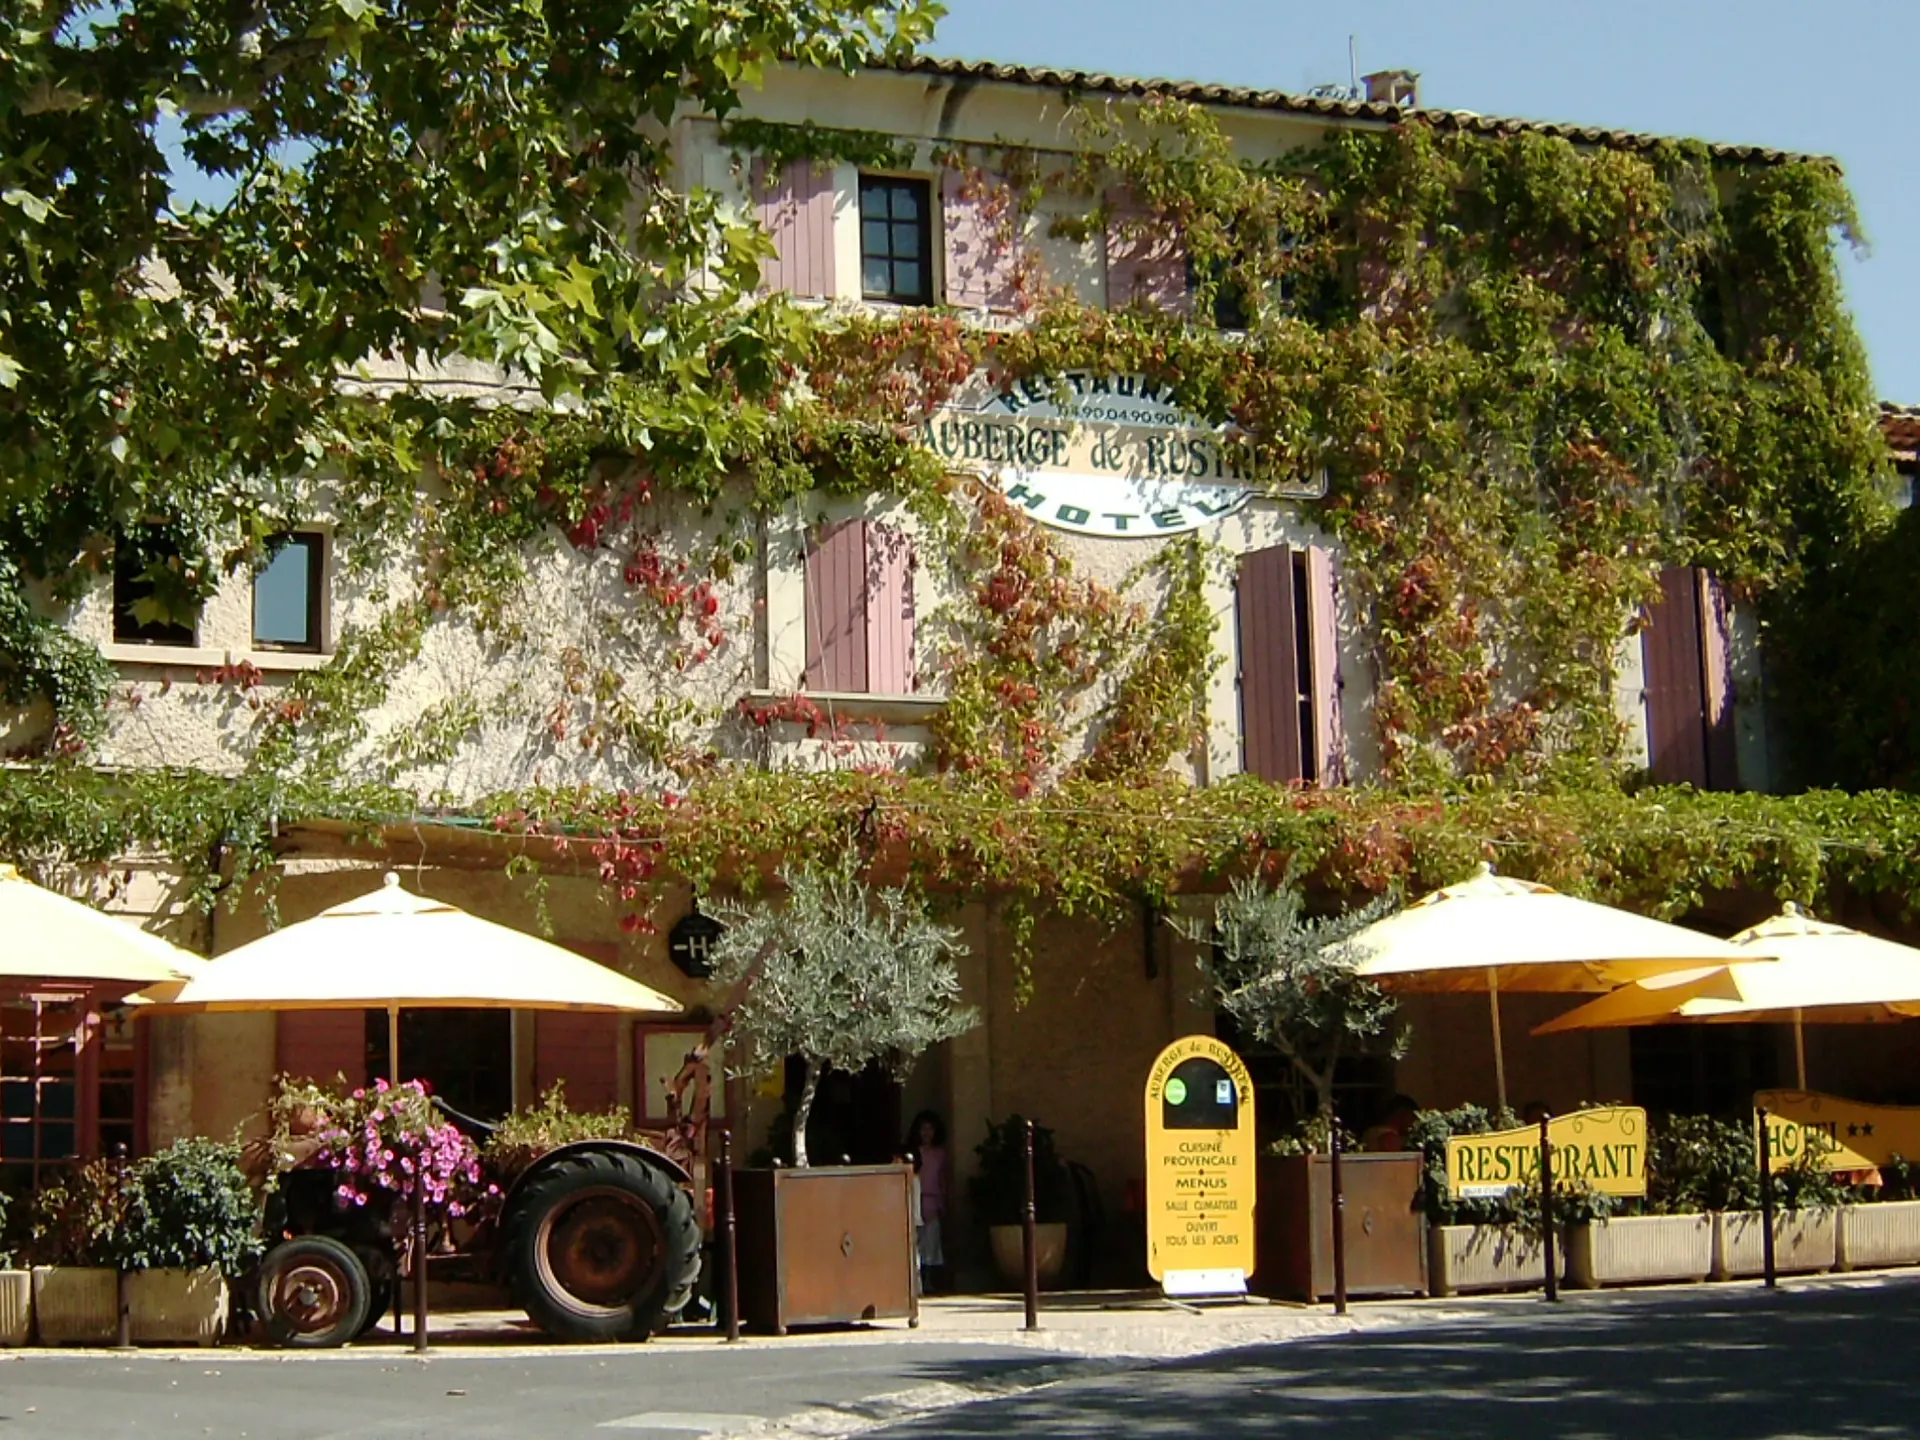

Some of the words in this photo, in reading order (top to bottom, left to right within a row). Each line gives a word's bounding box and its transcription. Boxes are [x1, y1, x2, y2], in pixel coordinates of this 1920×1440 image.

[922, 418, 1072, 467] AUBERGE
[1090, 430, 1123, 471] de
[1006, 483, 1231, 530] HOTEL
[1178, 1142, 1223, 1153] CUISINE
[1175, 1178, 1228, 1189] MENUS
[1165, 1200, 1188, 1211] SALLE
[1186, 1221, 1218, 1232] OUVERT
[1165, 1235, 1188, 1247] TOUS
[1192, 1235, 1206, 1246] LES
[1212, 1234, 1239, 1246] JOURS
